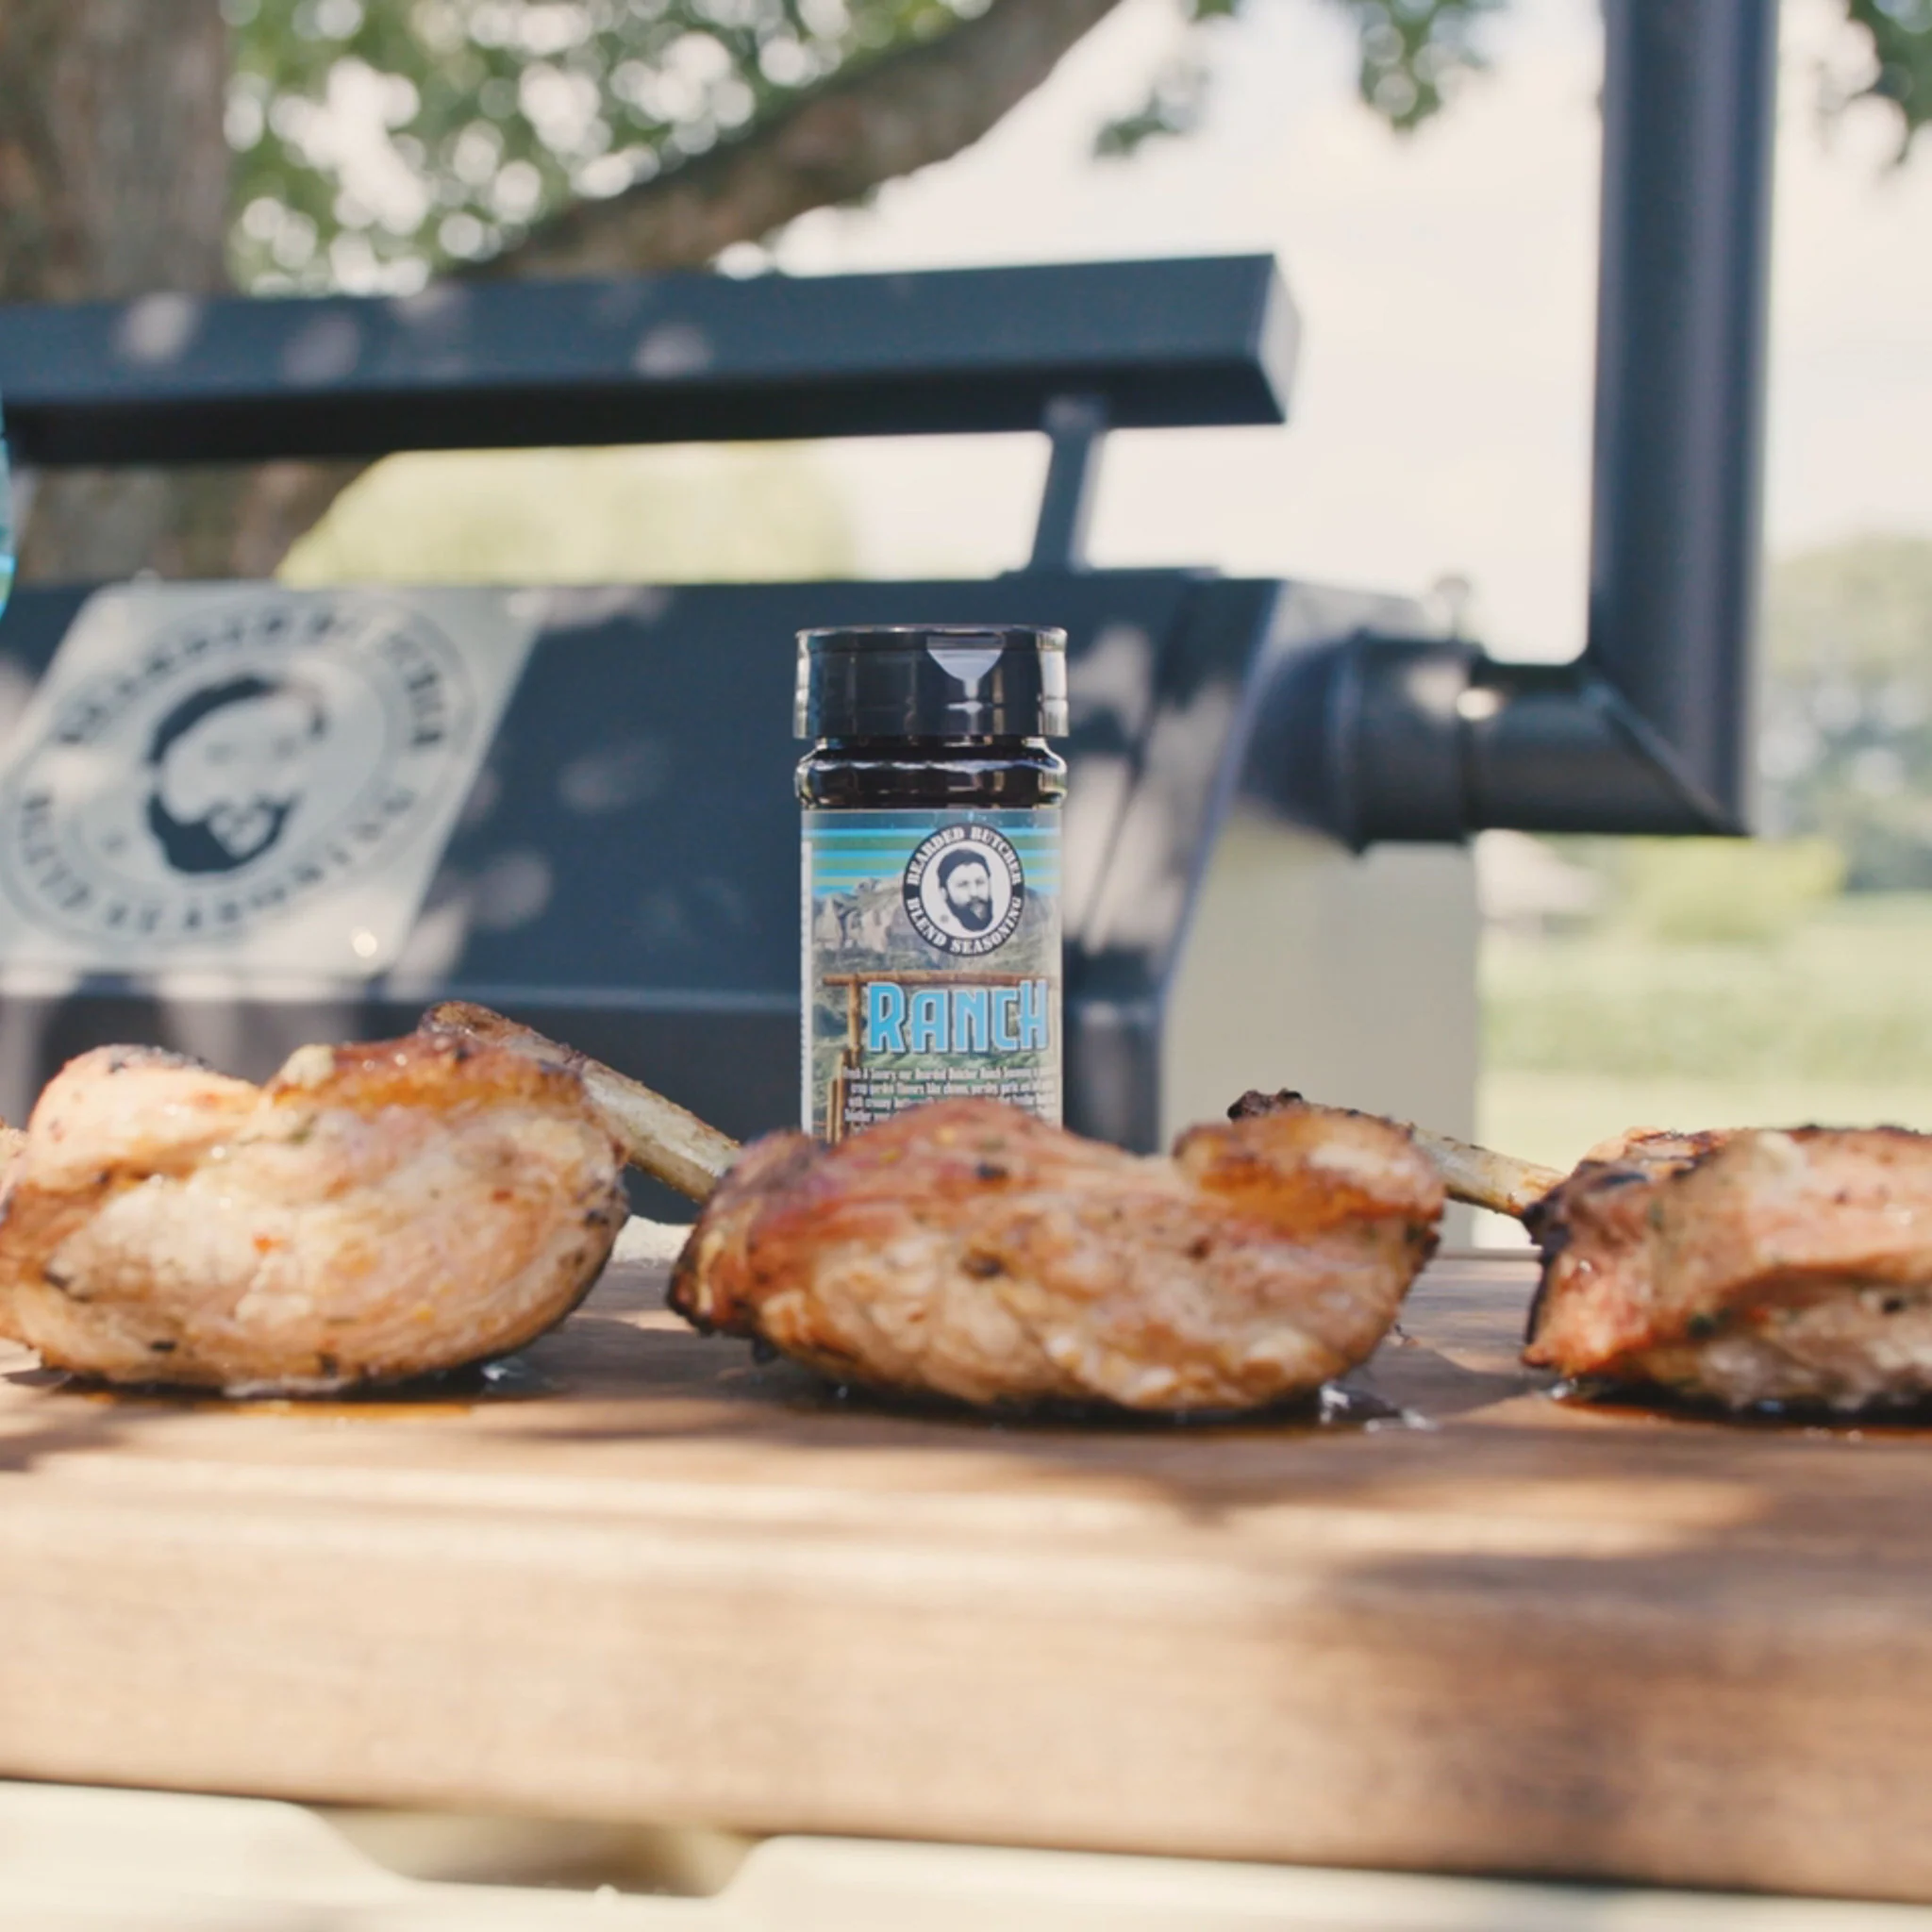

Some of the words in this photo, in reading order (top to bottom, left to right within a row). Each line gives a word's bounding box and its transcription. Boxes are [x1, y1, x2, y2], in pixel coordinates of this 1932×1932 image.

[907, 826, 965, 886] BEARDED
[970, 825, 1022, 886] BUTCHER
[907, 896, 948, 947] BLEND
[949, 896, 1023, 954] SEASONING
[867, 978, 1048, 1053] RANCH
